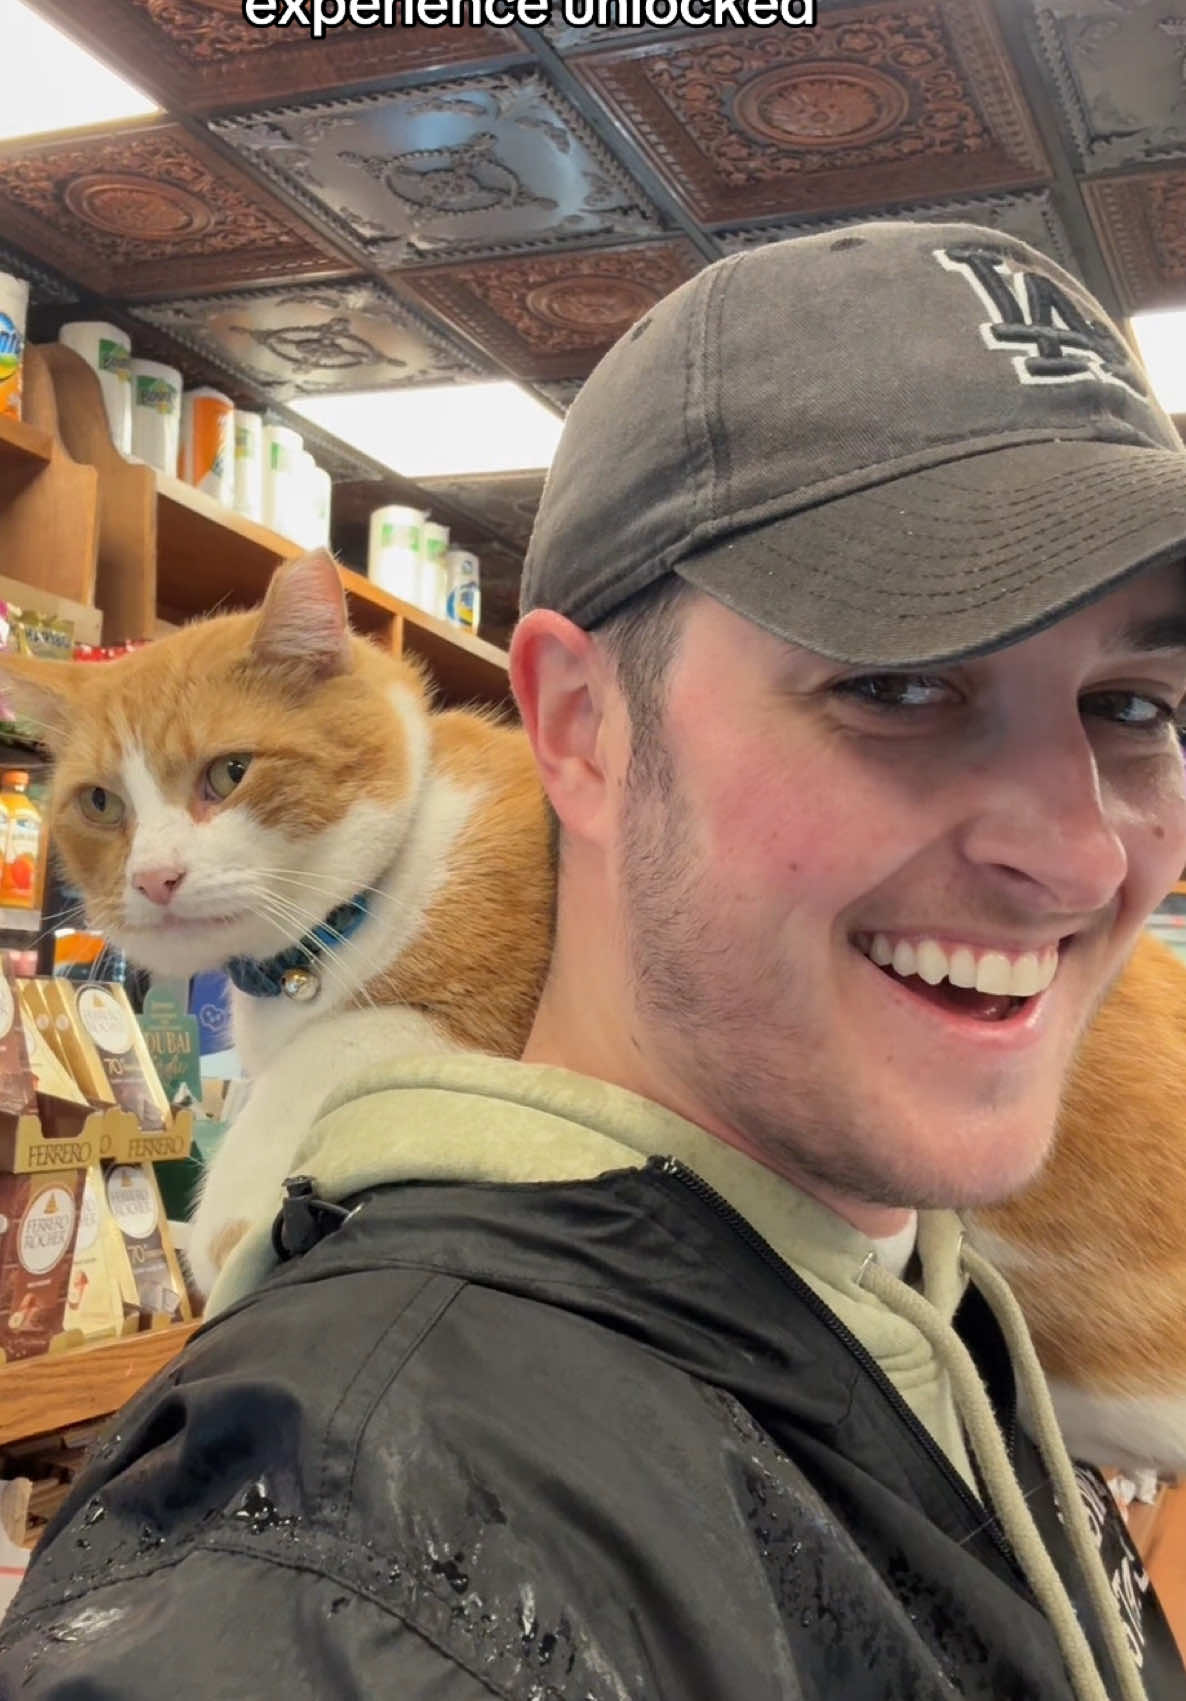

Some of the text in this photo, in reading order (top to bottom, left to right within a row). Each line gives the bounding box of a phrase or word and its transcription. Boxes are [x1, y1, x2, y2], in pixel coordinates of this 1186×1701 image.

[931, 244, 1149, 396] LA
[27, 1142, 92, 1168] FERRERO
[127, 1136, 185, 1159] FERRERO
